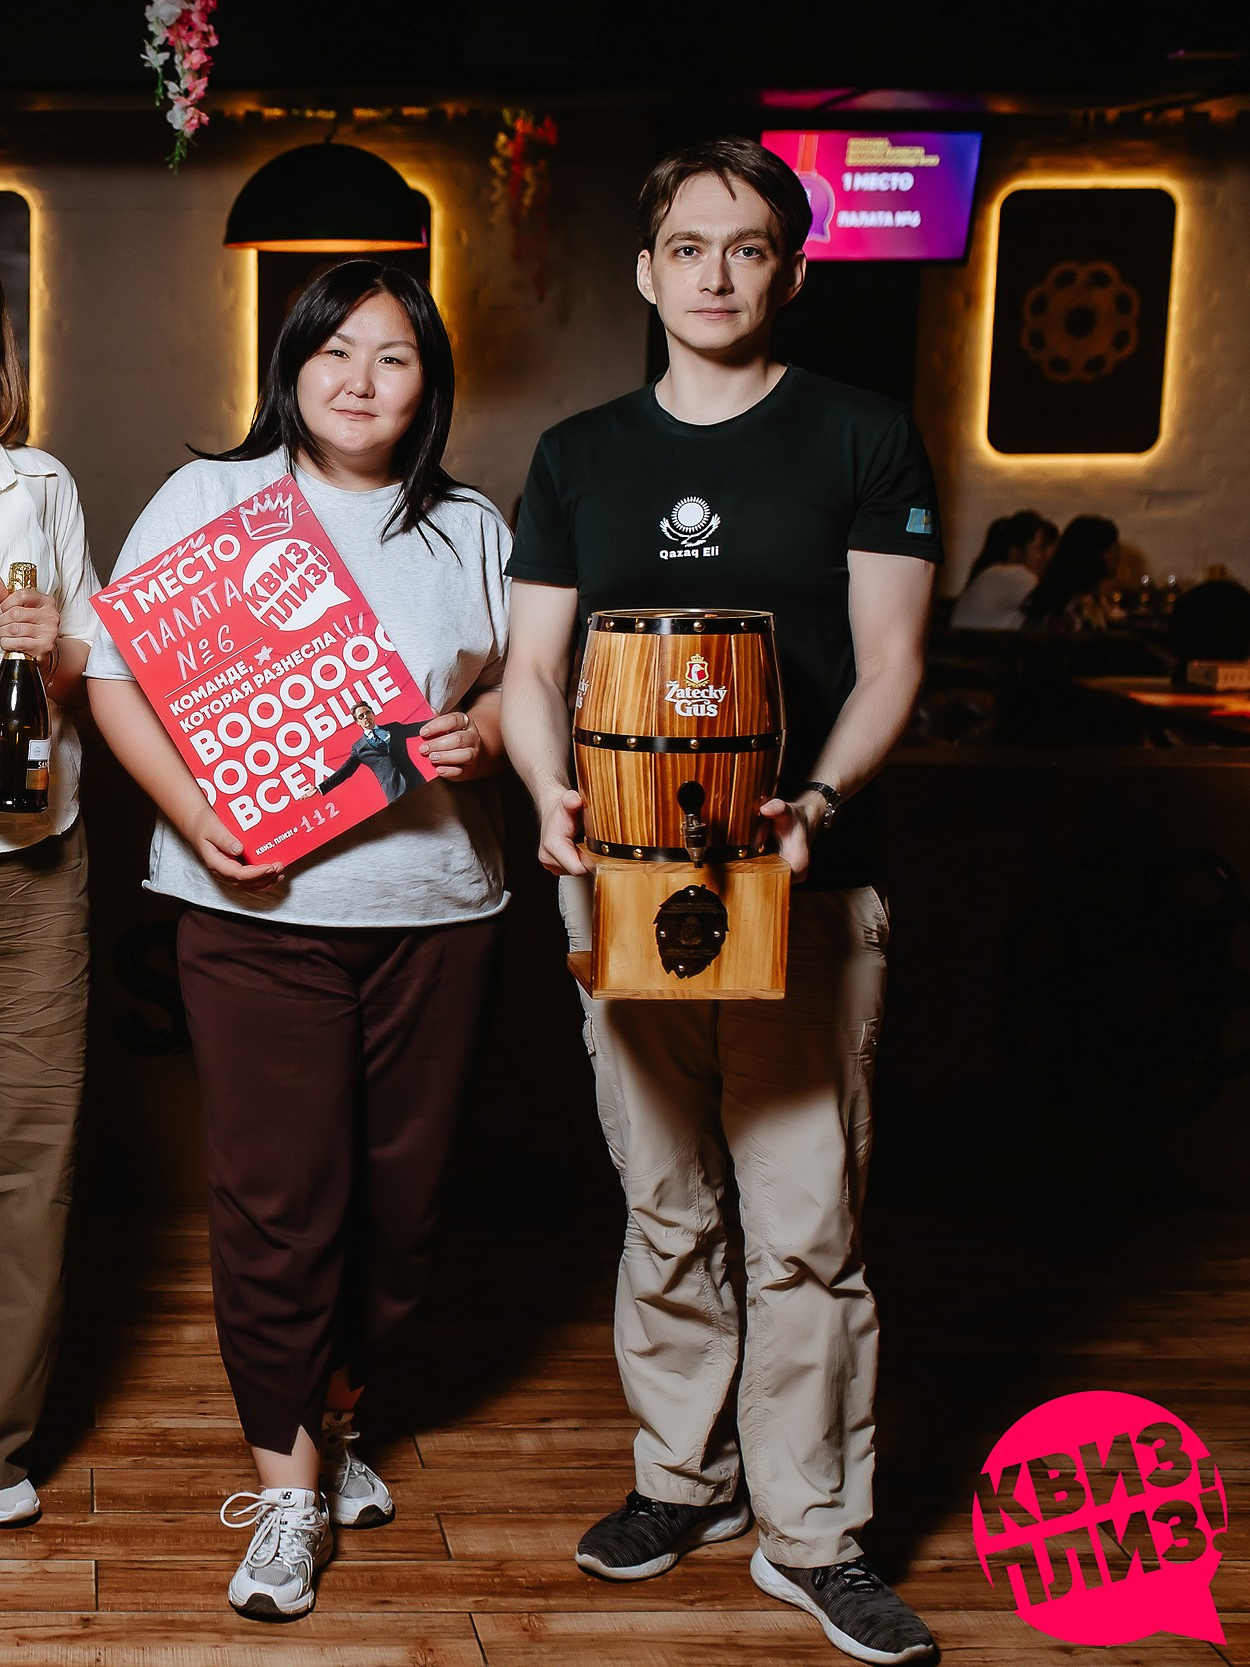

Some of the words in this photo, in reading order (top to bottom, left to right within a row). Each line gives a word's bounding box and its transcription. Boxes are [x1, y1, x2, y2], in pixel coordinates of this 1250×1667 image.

[852, 172, 914, 192] МЕСТО
[113, 599, 135, 624] 1
[132, 534, 241, 614] МЕСТО
[659, 547, 699, 559] Qazaq
[703, 546, 719, 557] Eli
[130, 576, 243, 664] ПАЛАТА
[169, 660, 255, 717] КОМАНДЕ,
[179, 680, 255, 734] КОТОРАЯ
[253, 631, 337, 689] РАЗНЕСЛА
[664, 680, 728, 703] Žatecký
[227, 747, 336, 832] ВСЕХ
[300, 802, 341, 833] 112
